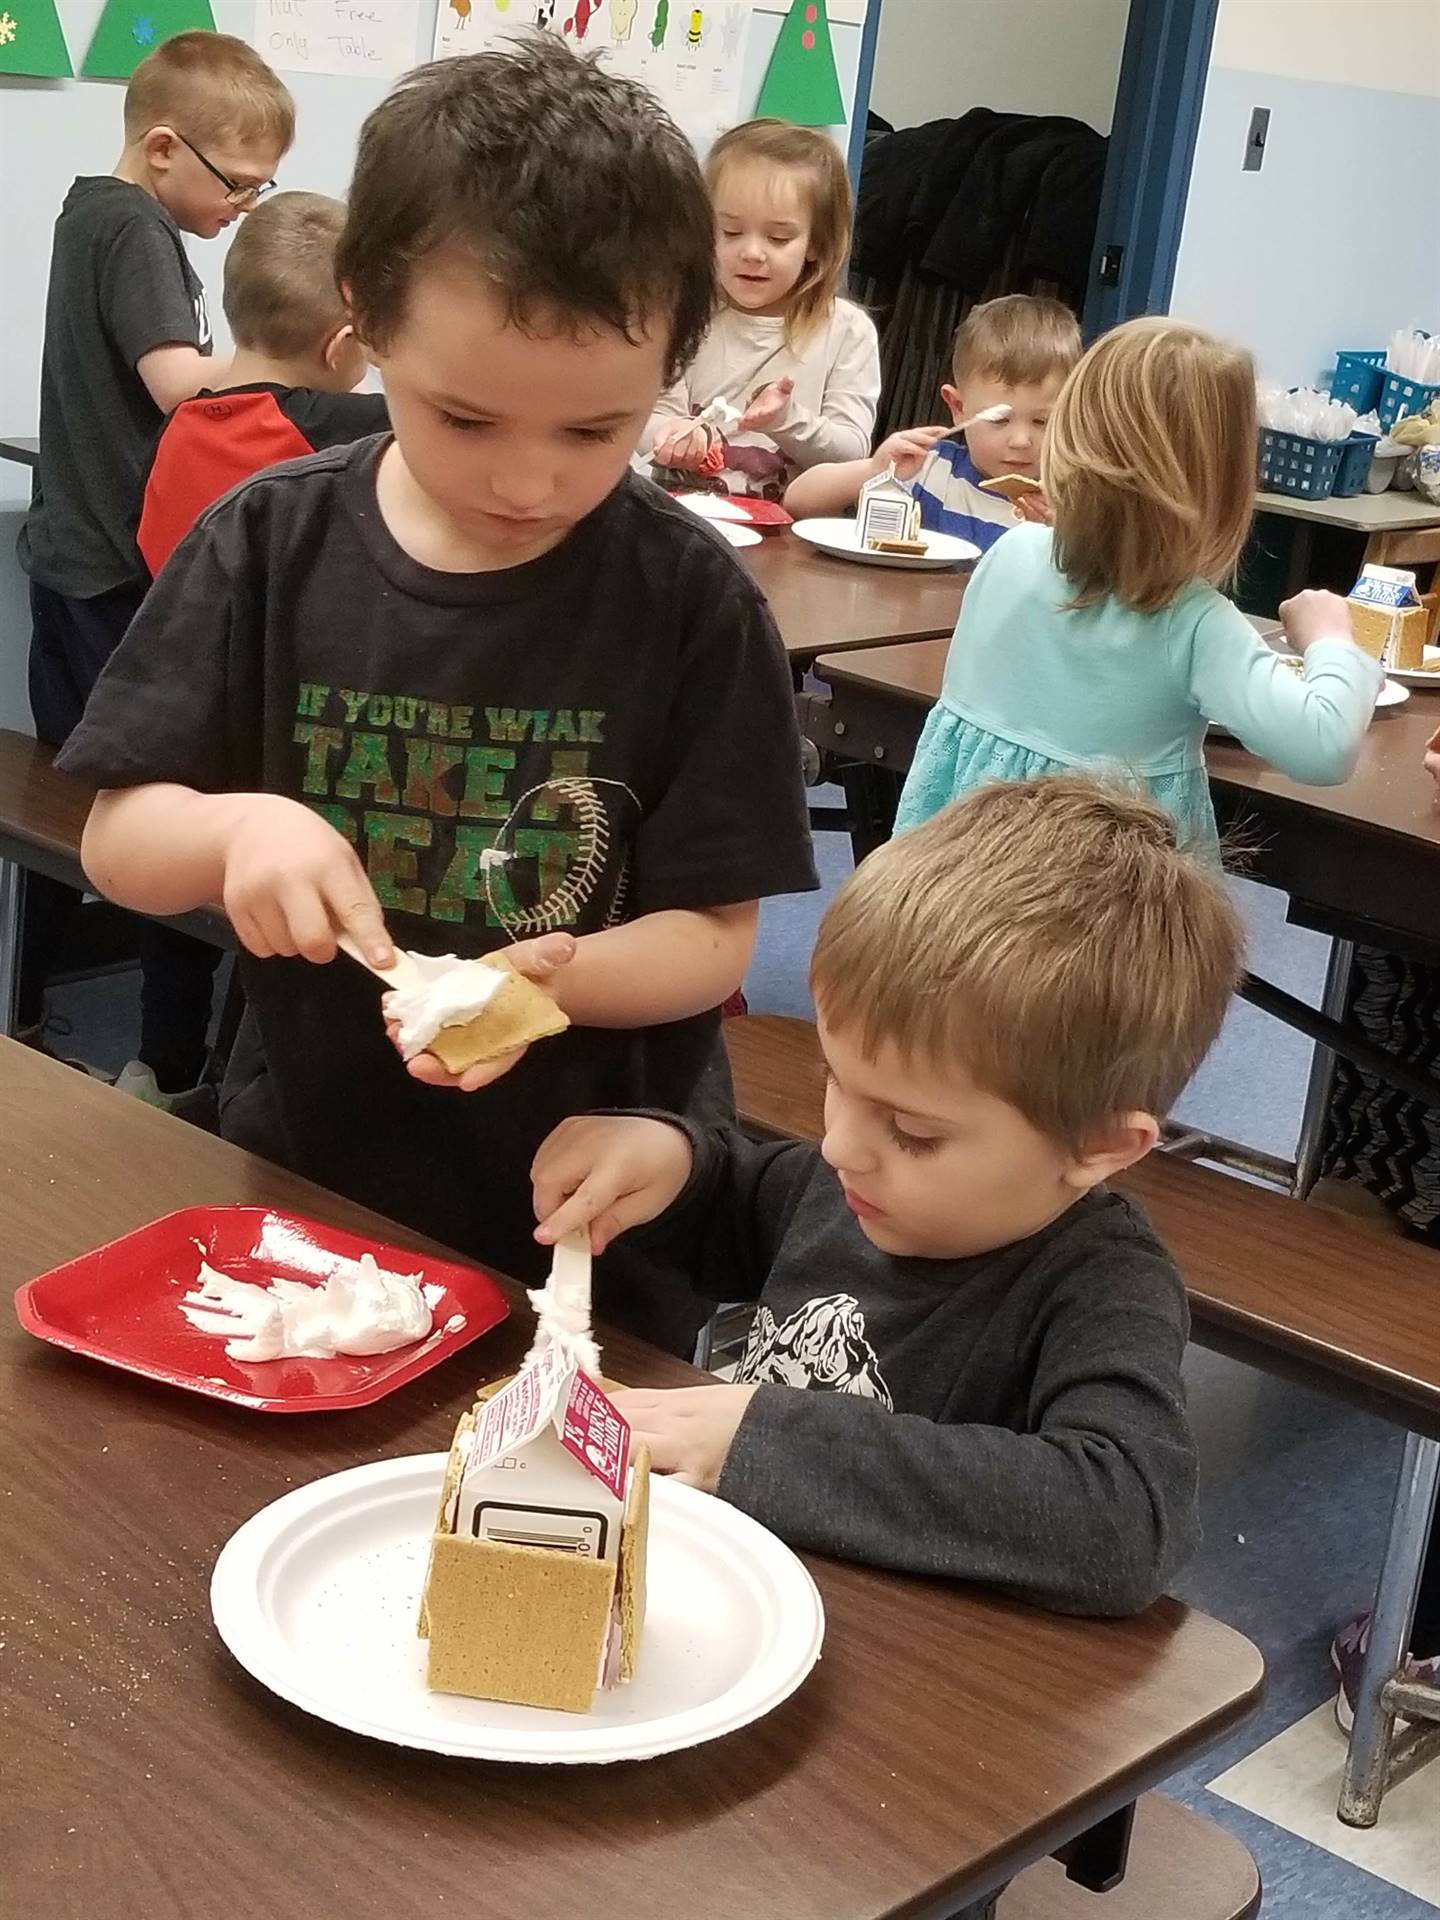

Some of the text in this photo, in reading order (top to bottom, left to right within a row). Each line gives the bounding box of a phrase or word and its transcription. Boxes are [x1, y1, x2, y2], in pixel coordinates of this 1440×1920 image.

[335, 0, 383, 23] Free
[269, 32, 383, 60] Only Table
[296, 682, 606, 744] IF YOU'RE WEAK
[292, 722, 592, 822] TAKE A
